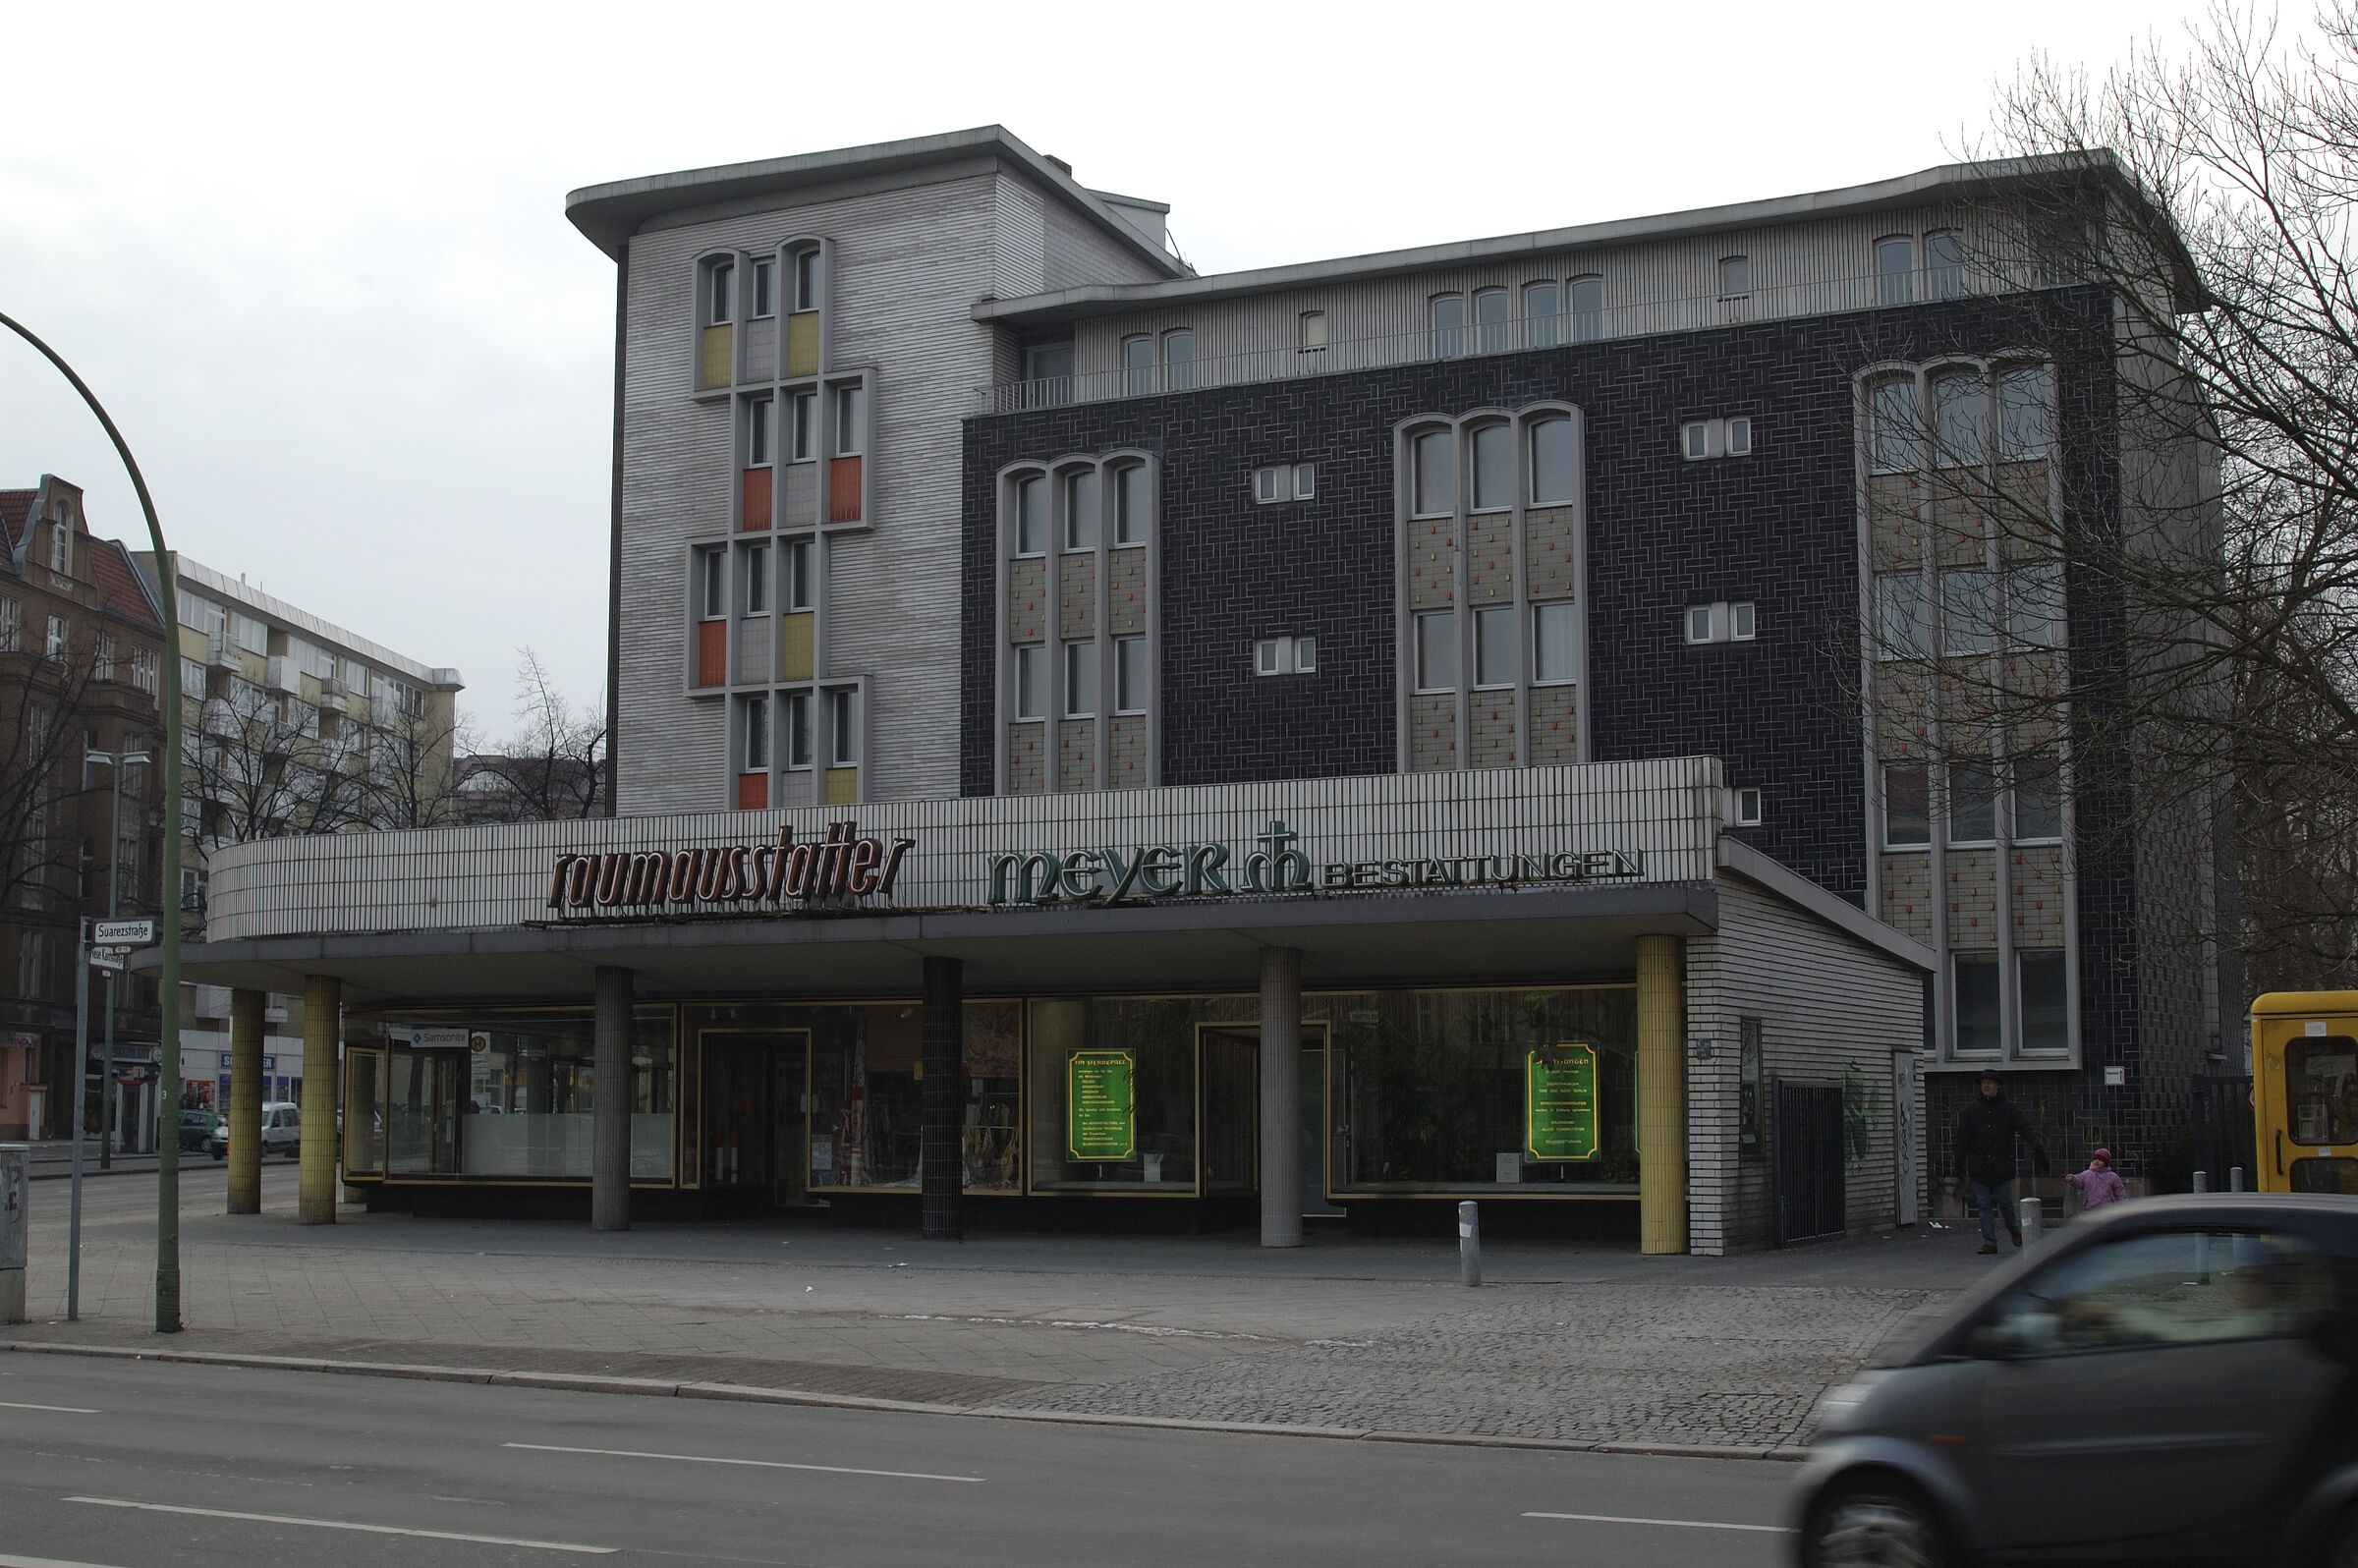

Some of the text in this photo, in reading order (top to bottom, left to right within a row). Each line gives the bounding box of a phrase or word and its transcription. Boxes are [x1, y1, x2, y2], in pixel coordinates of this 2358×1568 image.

[546, 821, 916, 908] raumausstatter
[1325, 848, 1645, 886] BESTATTUNGEN
[98, 923, 148, 939] Suarezstraße
[423, 1033, 467, 1042] Samsonite
